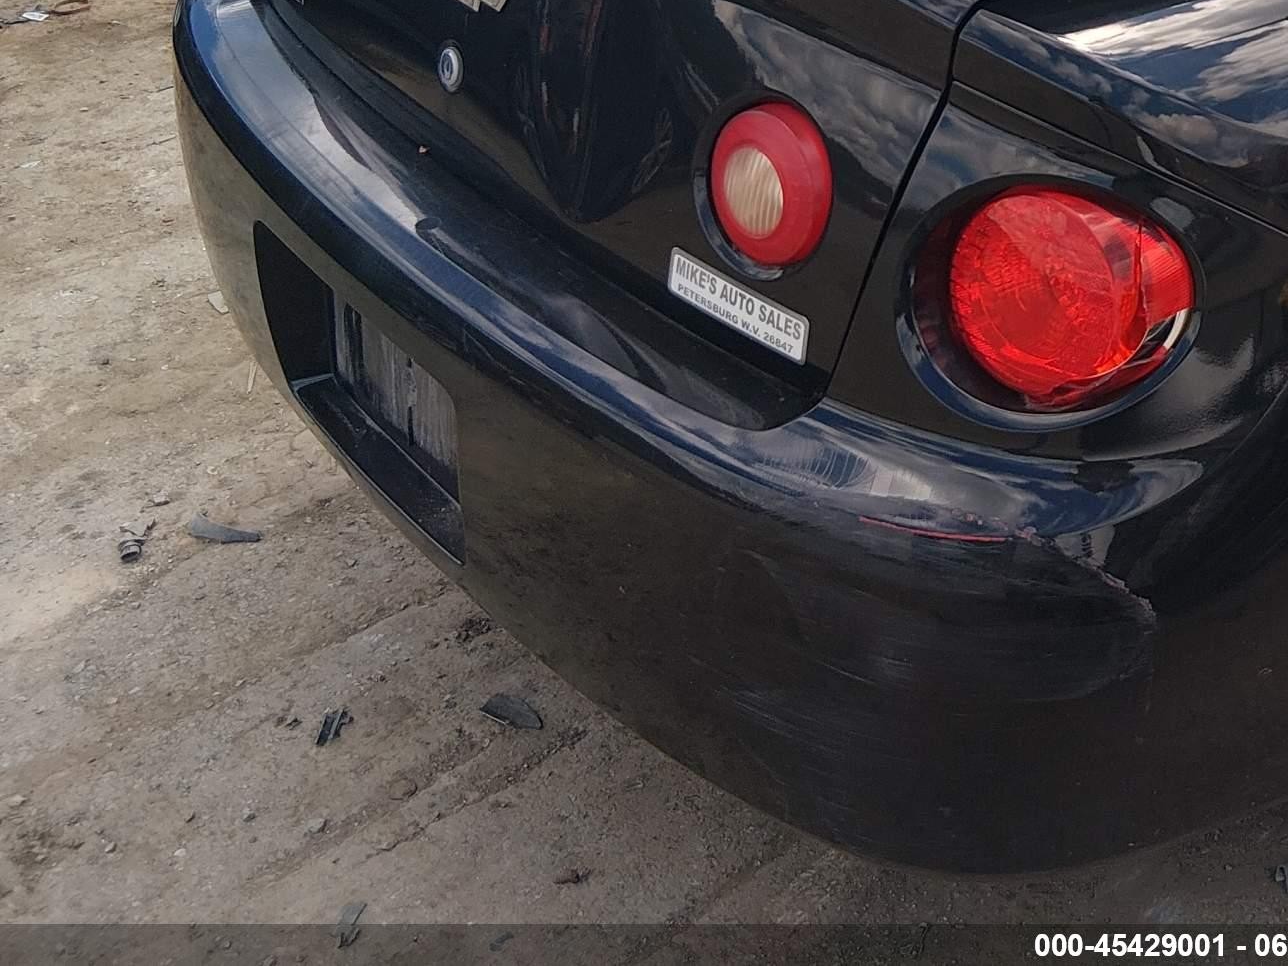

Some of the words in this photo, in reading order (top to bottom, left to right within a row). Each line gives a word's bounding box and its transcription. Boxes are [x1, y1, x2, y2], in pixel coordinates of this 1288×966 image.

[675, 257, 717, 294] MIKE'S
[720, 284, 755, 315] AUTO
[758, 304, 801, 340] SALES
[677, 283, 739, 325] PETERSBURG
[741, 319, 761, 337] W.V.
[764, 332, 793, 354] 26847
